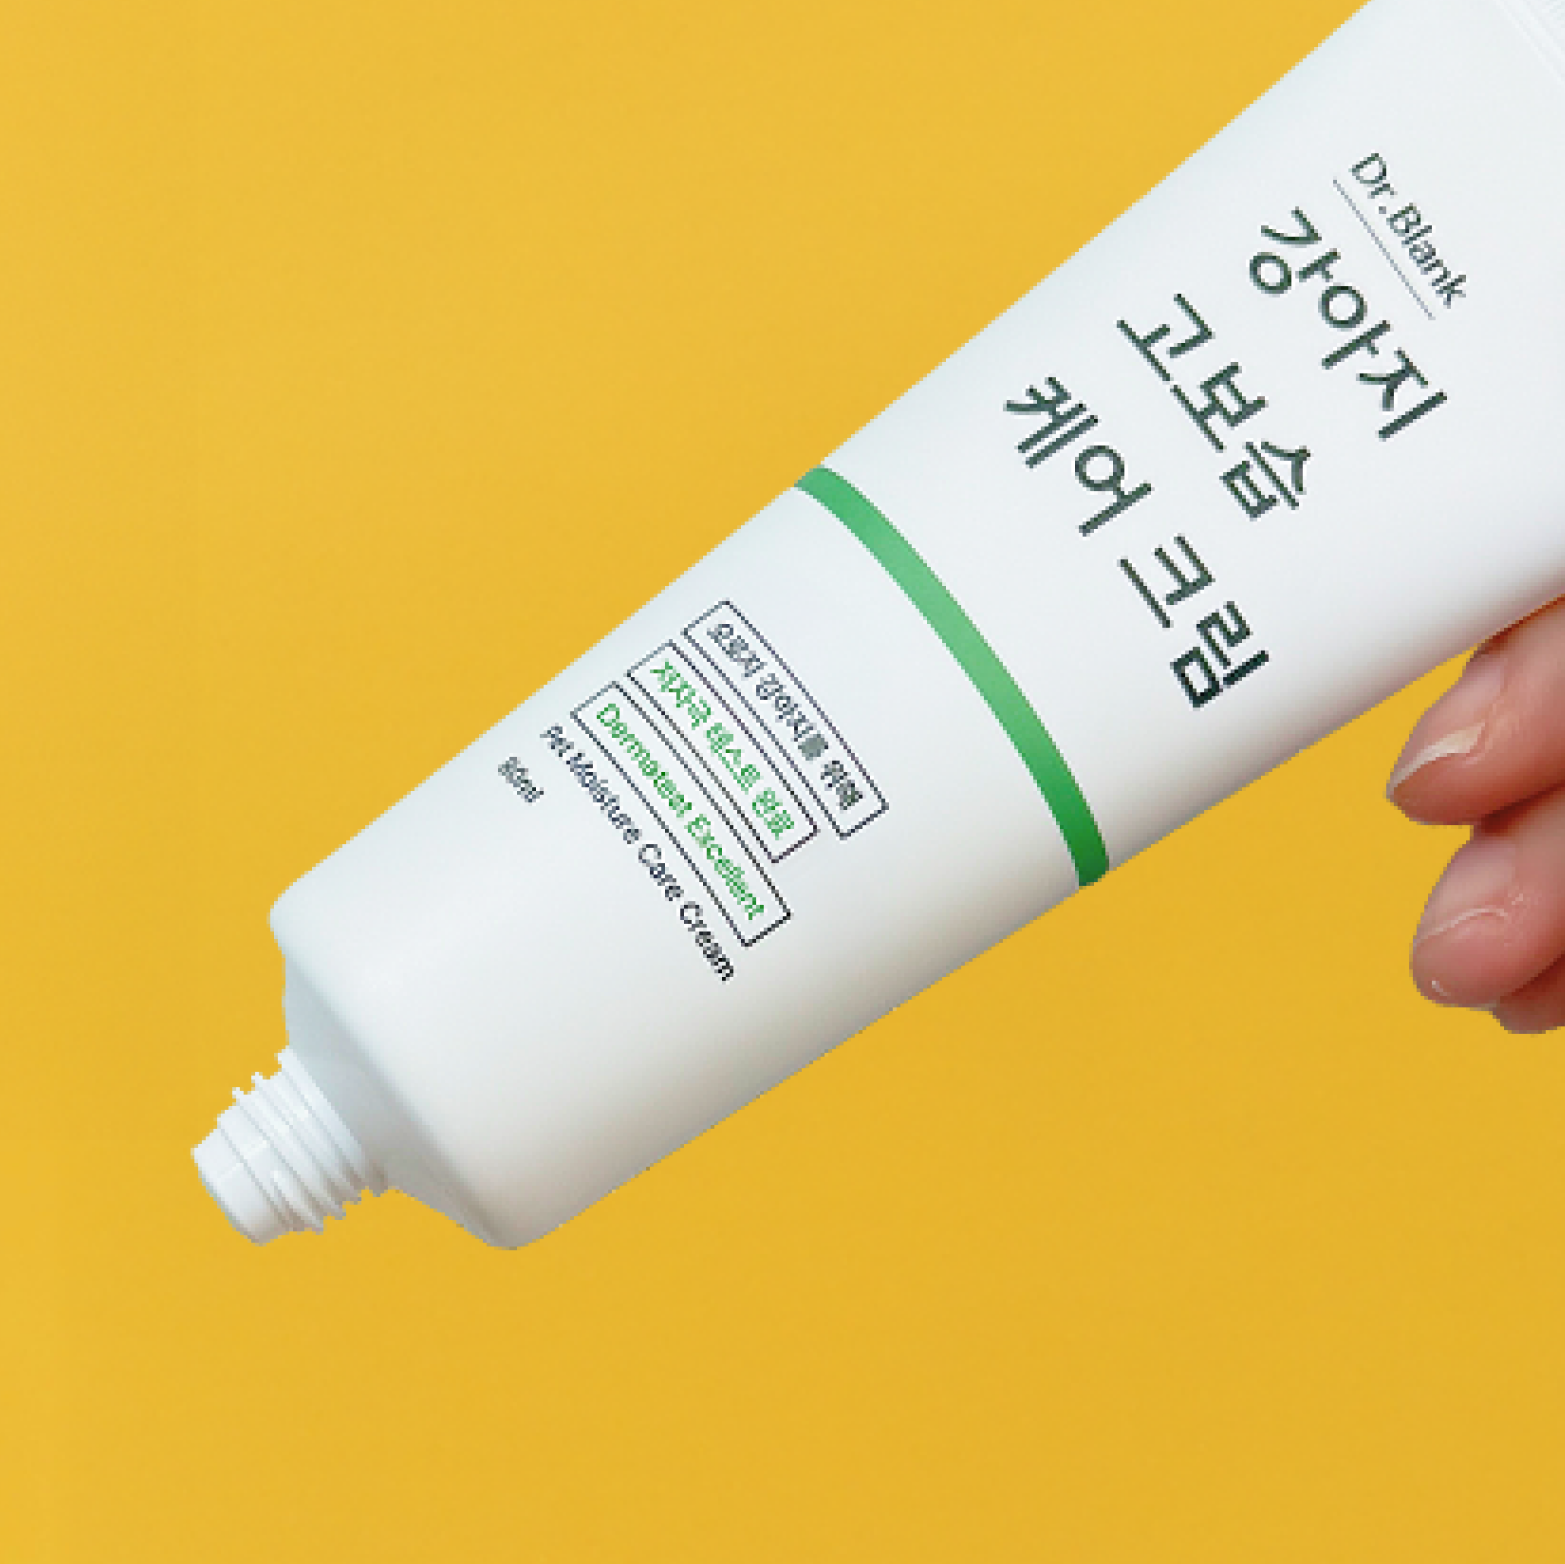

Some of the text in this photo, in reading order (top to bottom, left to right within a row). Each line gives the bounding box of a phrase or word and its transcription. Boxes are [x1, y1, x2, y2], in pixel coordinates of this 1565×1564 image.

[1249, 207, 1447, 440] 강아지
[1349, 152, 1466, 308] Dr.Blank
[1117, 293, 1310, 519] 고보습
[1003, 377, 1269, 708] 케어 크림
[649, 661, 795, 840] 저자극 테스트 완료
[707, 623, 768, 677] 오로지
[755, 673, 828, 761] 강아지를
[540, 723, 734, 982] Pet Moisture Care Cream
[596, 703, 765, 920] Dermatest Excellent
